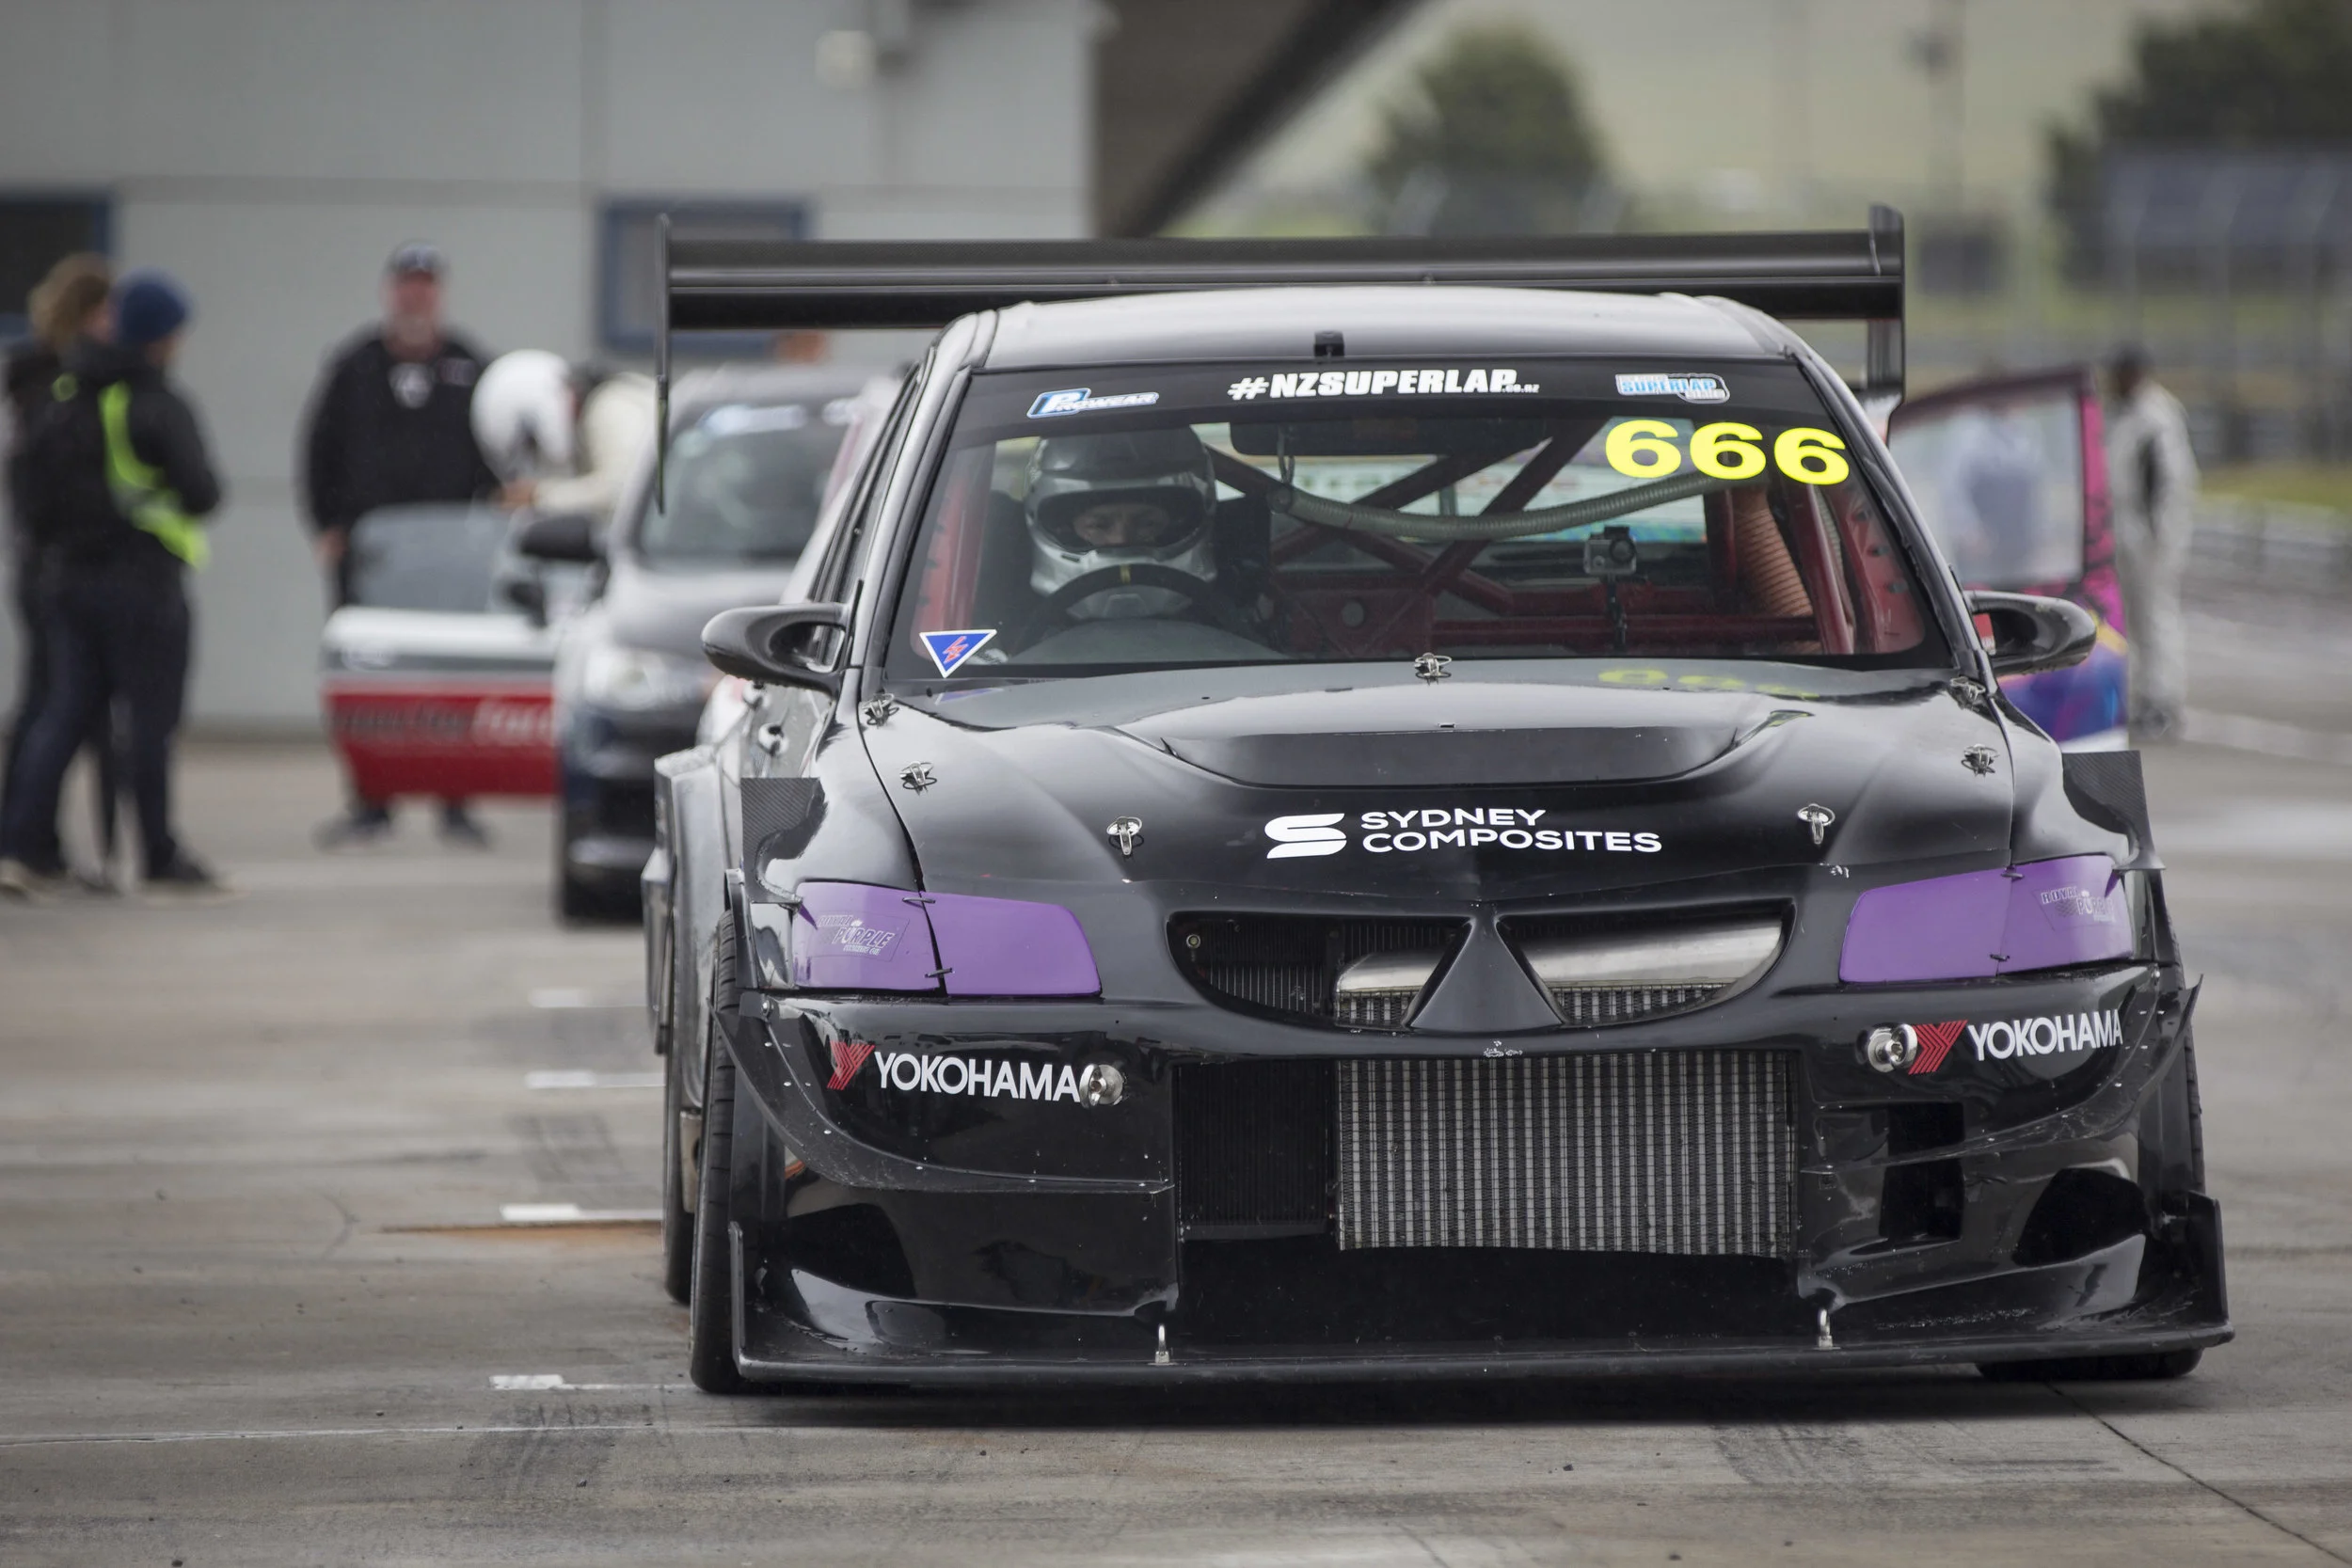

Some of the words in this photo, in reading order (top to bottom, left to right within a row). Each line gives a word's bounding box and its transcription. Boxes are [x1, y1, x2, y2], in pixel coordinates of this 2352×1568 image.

[1605, 420, 1850, 485] 666
[1360, 808, 1546, 830] SYDNEY
[1362, 829, 1662, 853] COMPOSITES
[1967, 1009, 2123, 1061] YOKOHAMA
[874, 1051, 1081, 1103] YOKOHAMA
